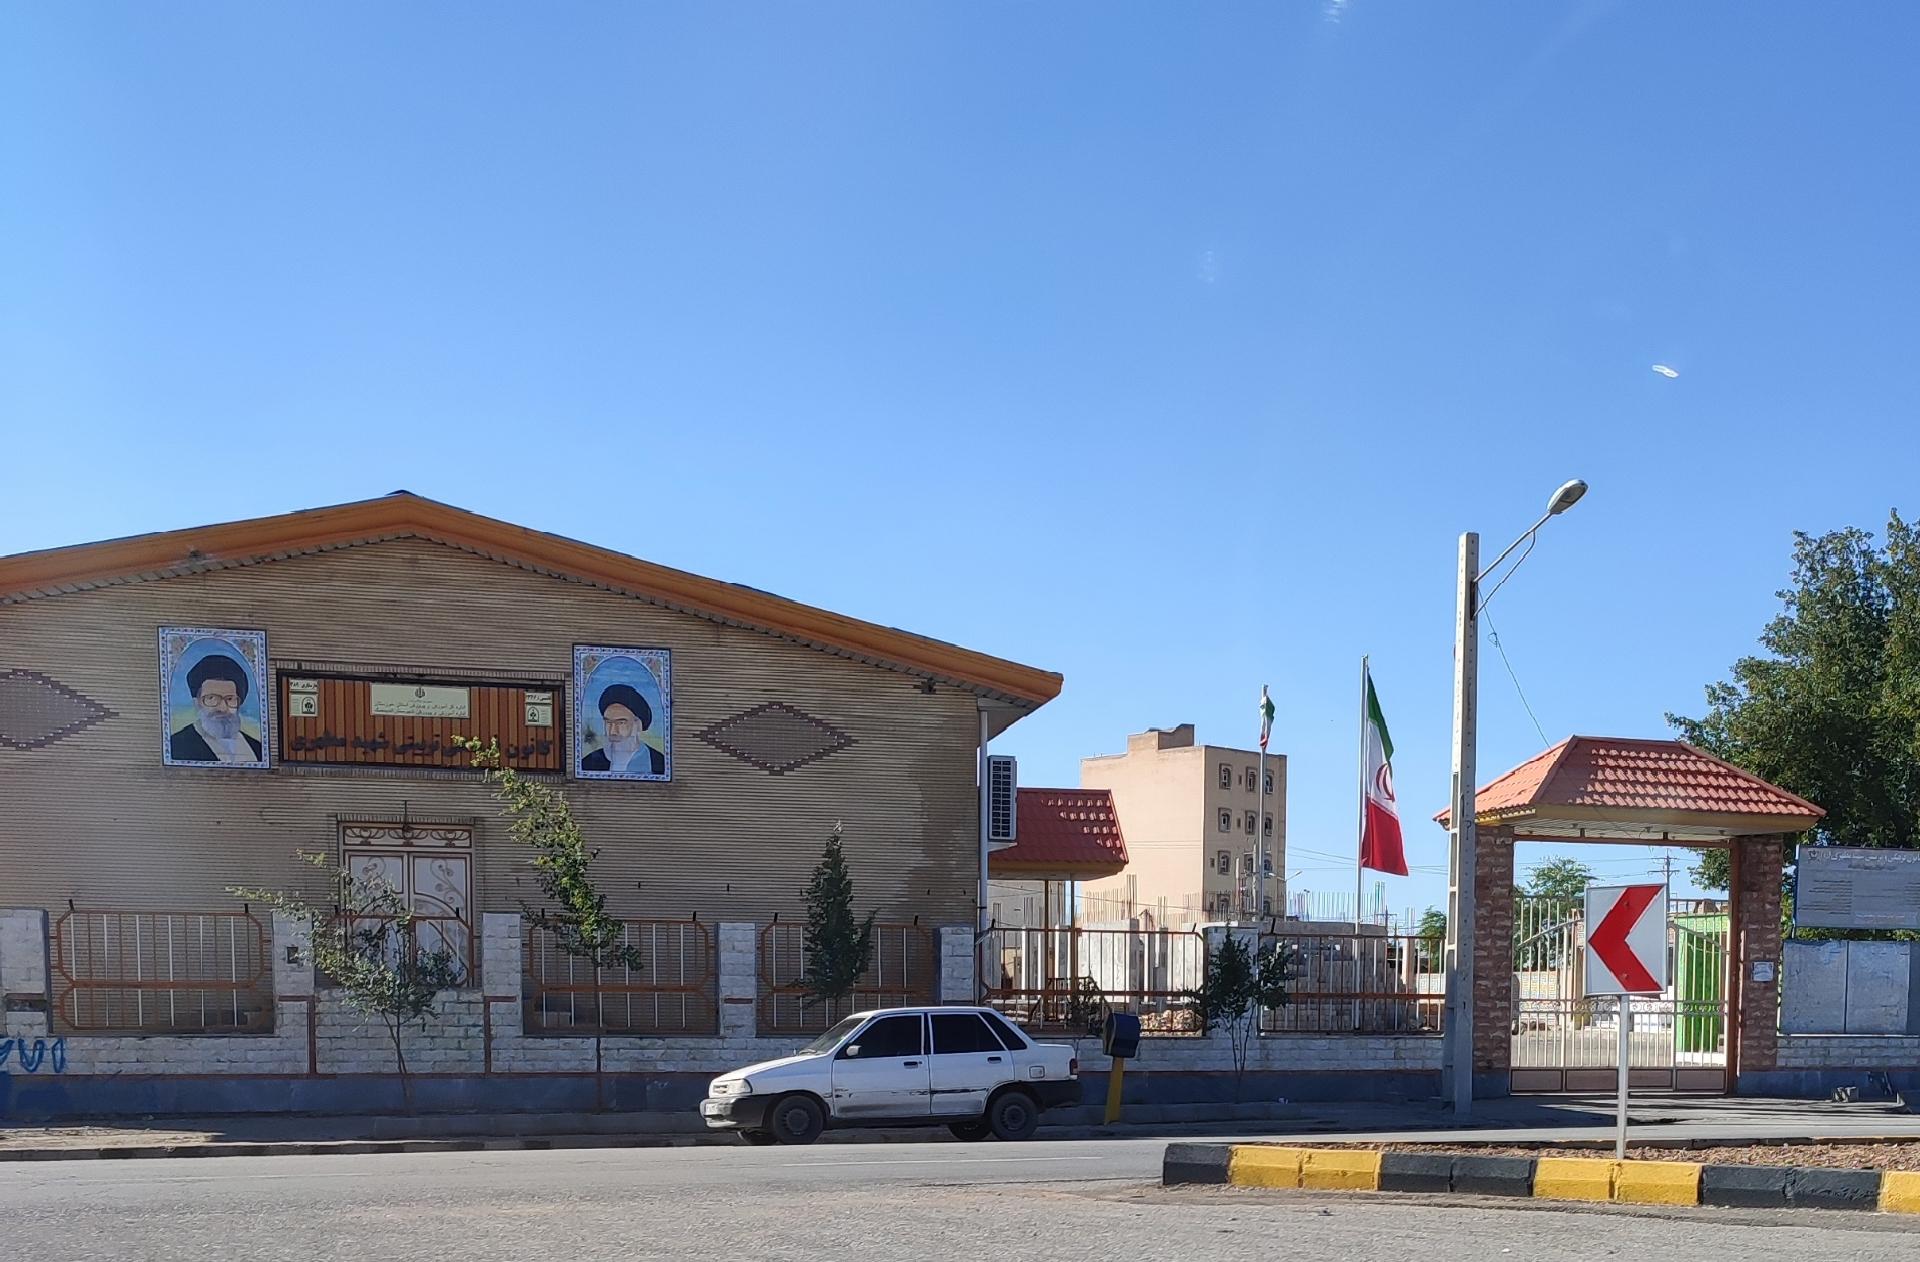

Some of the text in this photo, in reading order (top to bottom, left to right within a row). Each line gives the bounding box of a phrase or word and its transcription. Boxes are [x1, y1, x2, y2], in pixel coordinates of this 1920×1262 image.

[291, 730, 346, 751] مطهری
[352, 731, 389, 755] شهید
[506, 738, 553, 759] کانون
